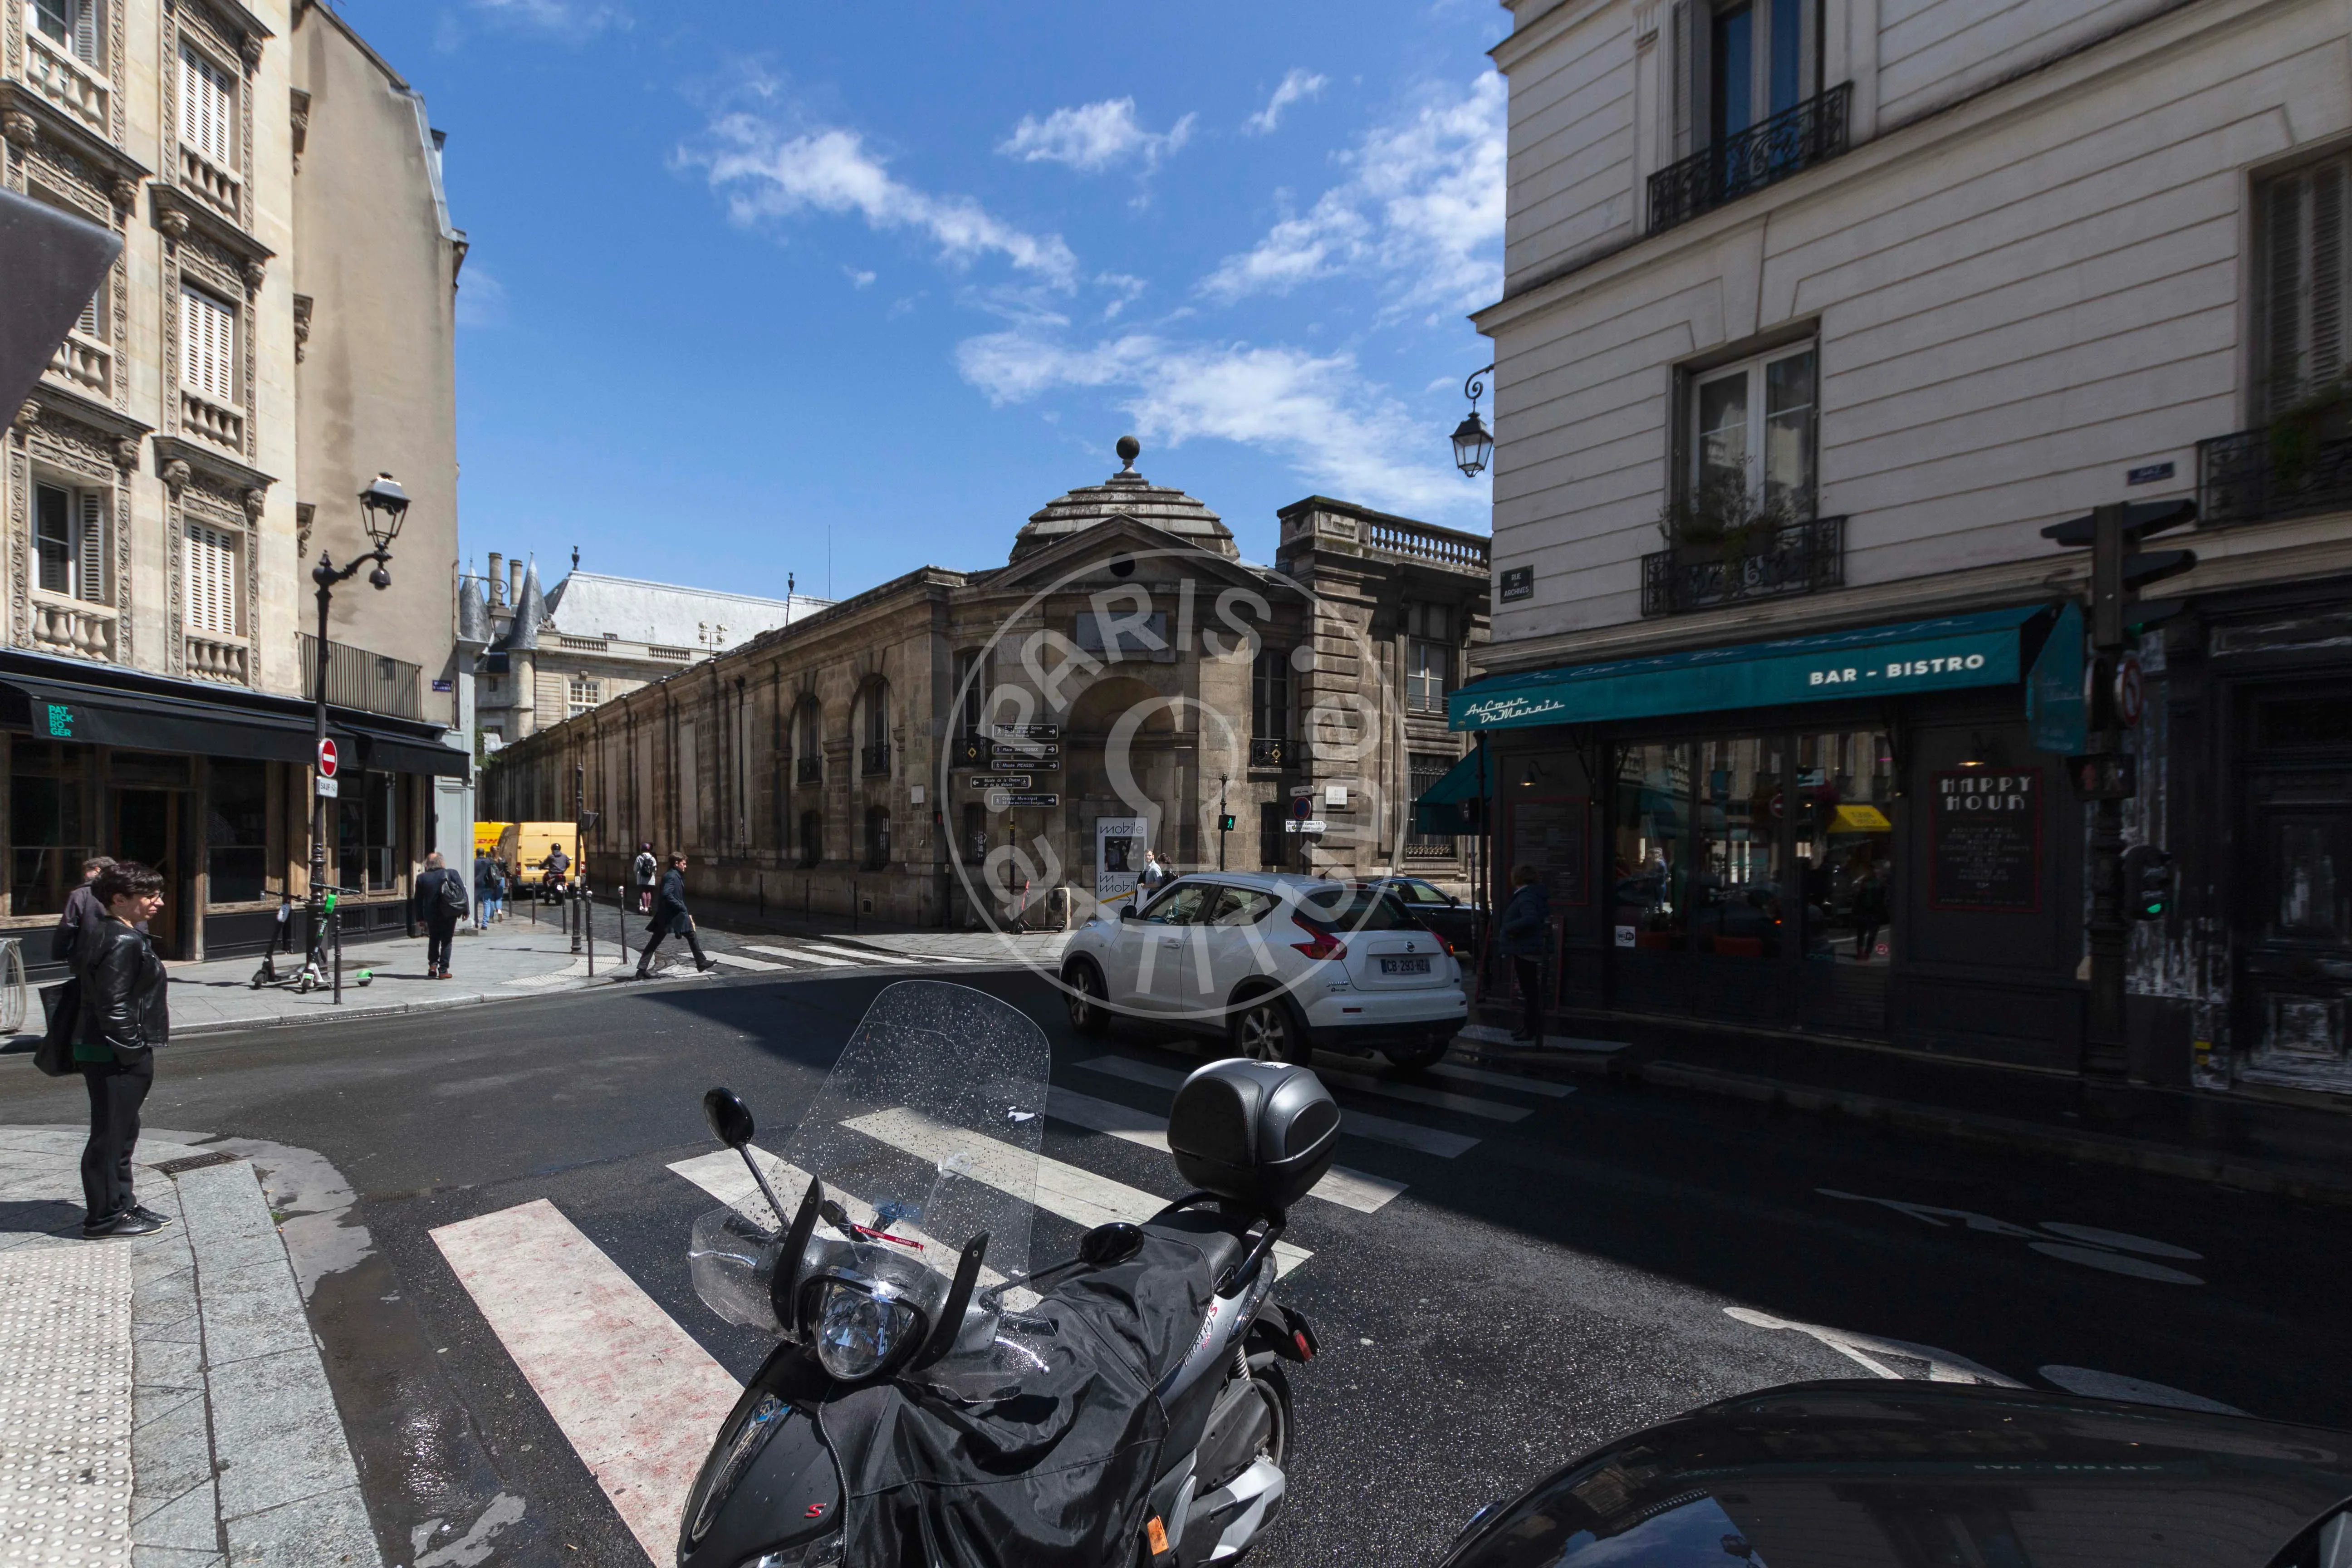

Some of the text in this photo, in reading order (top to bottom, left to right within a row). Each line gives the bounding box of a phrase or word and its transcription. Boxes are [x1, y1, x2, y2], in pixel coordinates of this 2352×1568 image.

[1511, 573, 1521, 581] RUE
[1504, 586, 1529, 597] ARCHIVES
[1809, 668, 1857, 686] BAR
[1886, 654, 1984, 678] BISTRO
[48, 704, 68, 714] PAT
[1480, 700, 1565, 724] Du Marais
[49, 713, 74, 722] RICK
[50, 728, 72, 736] GER
[1941, 776, 2031, 793] HAPPY
[1946, 794, 2025, 811] HOUR
[1100, 822, 1143, 834] mobile
[1100, 872, 1114, 883] im
[1100, 881, 1135, 892] mobil
[861, 1227, 885, 1238] ATTENZIONE!
[805, 1503, 827, 1518] S
